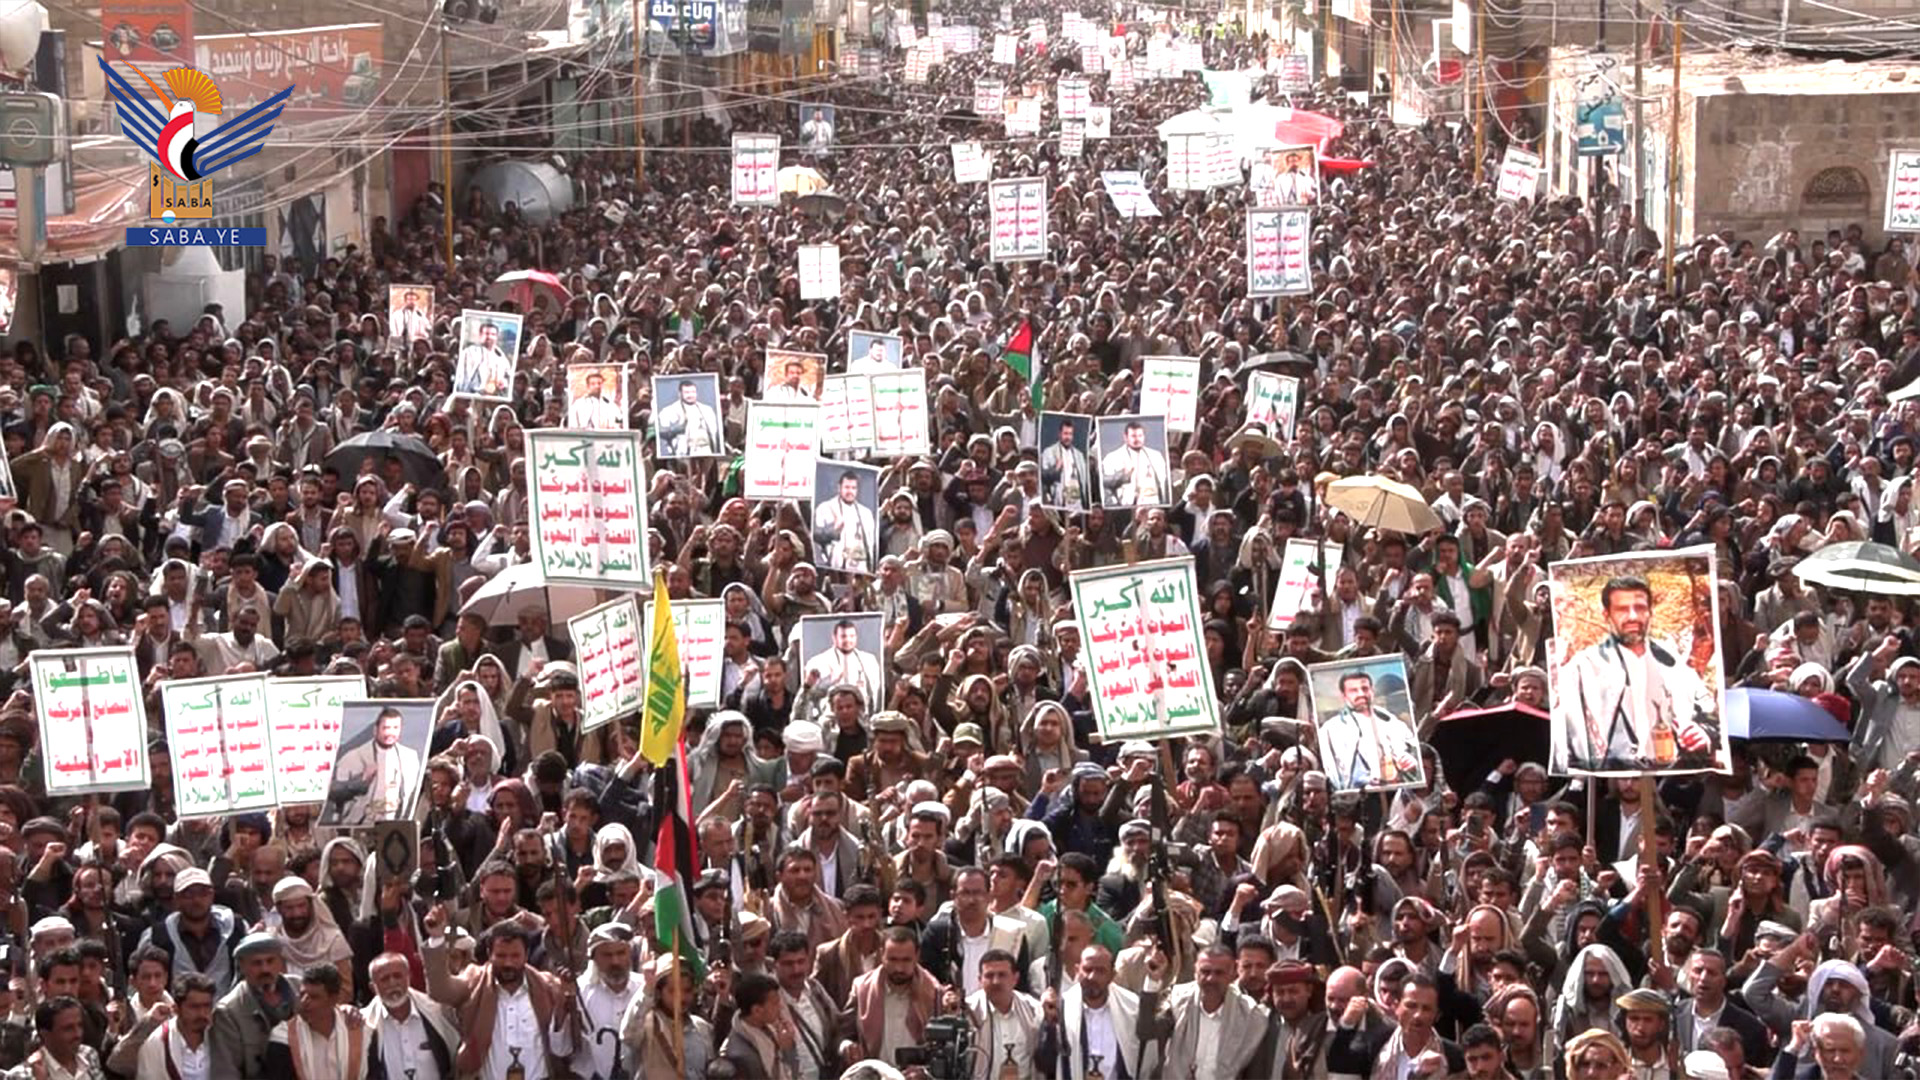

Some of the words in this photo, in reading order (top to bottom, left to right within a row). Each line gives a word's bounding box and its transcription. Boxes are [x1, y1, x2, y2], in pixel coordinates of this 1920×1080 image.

[539, 440, 593, 473] أكبر
[597, 444, 631, 468] الله
[539, 473, 589, 496] لأمريكا
[591, 479, 633, 496] الموت
[594, 505, 634, 522] الموت
[544, 528, 577, 546] اليهود
[581, 530, 600, 546] على
[605, 528, 636, 545] اللعنة
[599, 550, 638, 575] النصر
[1089, 577, 1143, 620] أكبر
[1150, 578, 1185, 604] الله
[1147, 614, 1190, 636] الموت
[1153, 643, 1195, 662] الموت
[42, 664, 128, 693] قاطعوا
[1102, 678, 1139, 700] اليهود
[1144, 674, 1164, 694] على
[1167, 670, 1200, 688] اللعنة
[230, 687, 261, 705] الله
[93, 698, 132, 720] البضائع
[1164, 694, 1206, 725] النصر
